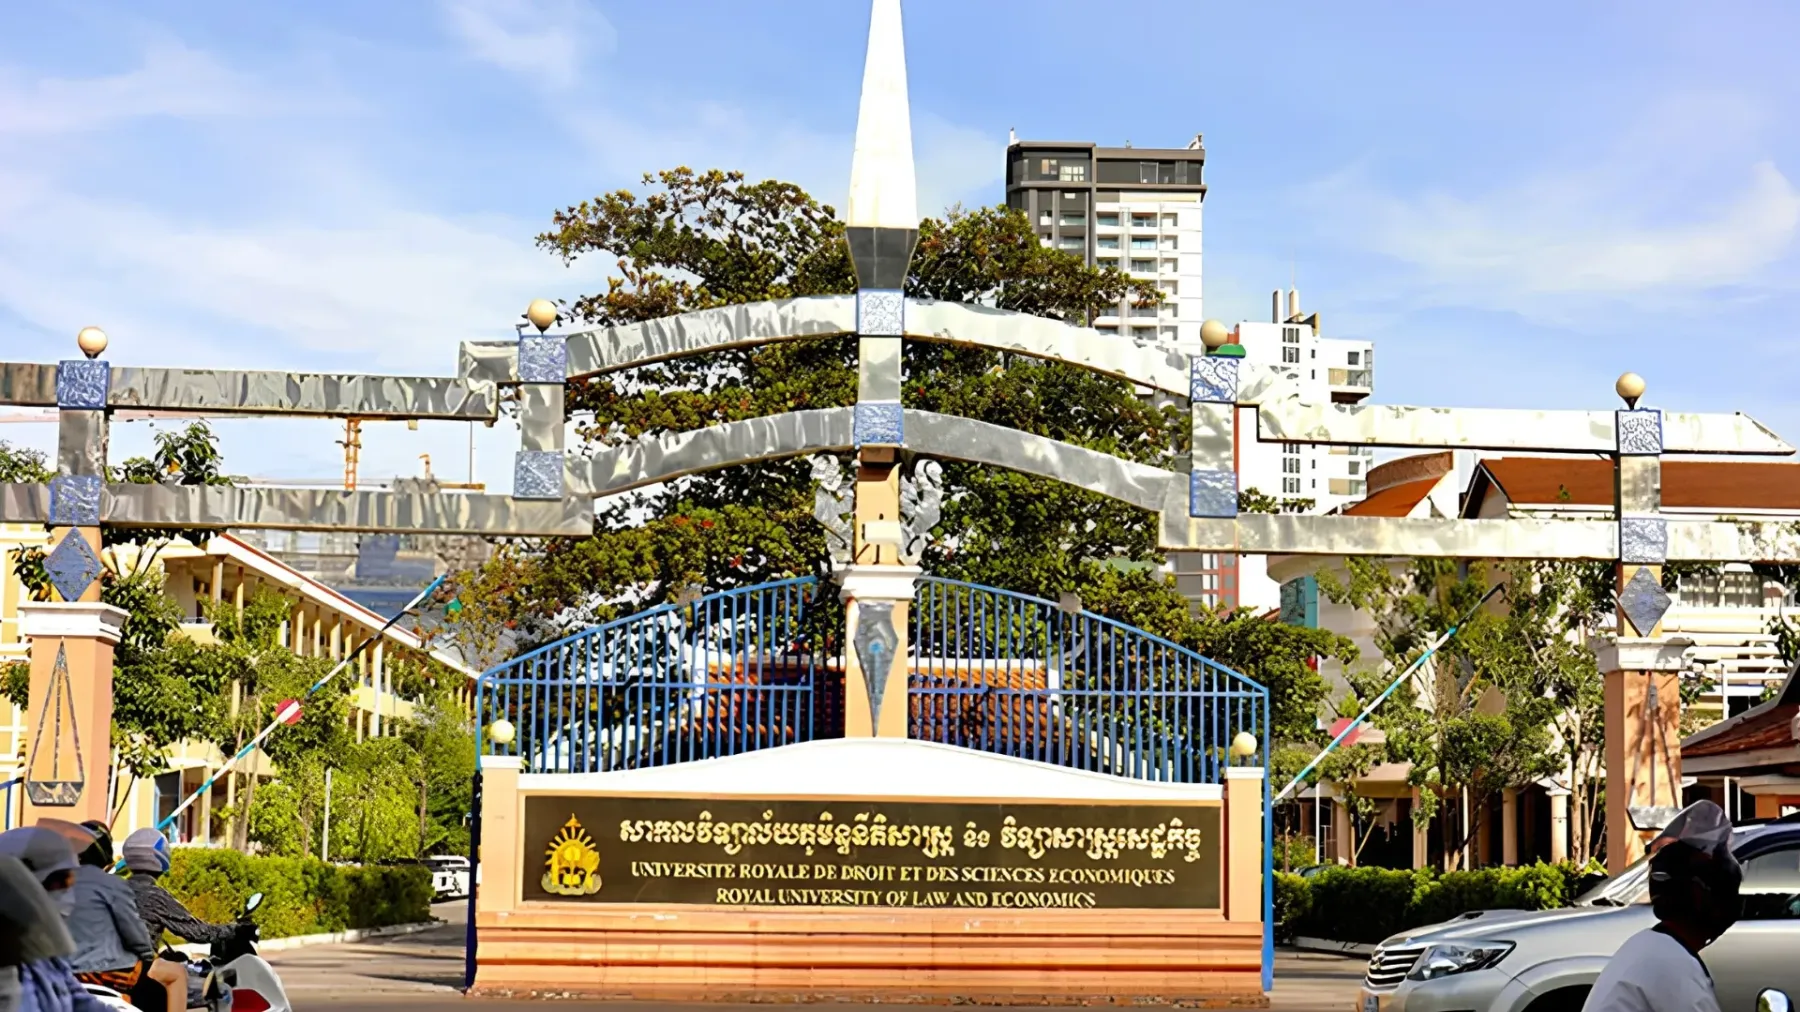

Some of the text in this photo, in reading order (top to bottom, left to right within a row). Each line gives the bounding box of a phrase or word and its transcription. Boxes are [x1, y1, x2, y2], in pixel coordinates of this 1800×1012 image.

[631, 862, 1176, 887] UNIVERSITE ROYALE DE DROIT ET DES SCIENCES ECONOMIQUES
[716, 888, 1096, 908] ROYAL UNIVERSITY OF LAW AND ECONOMICS
